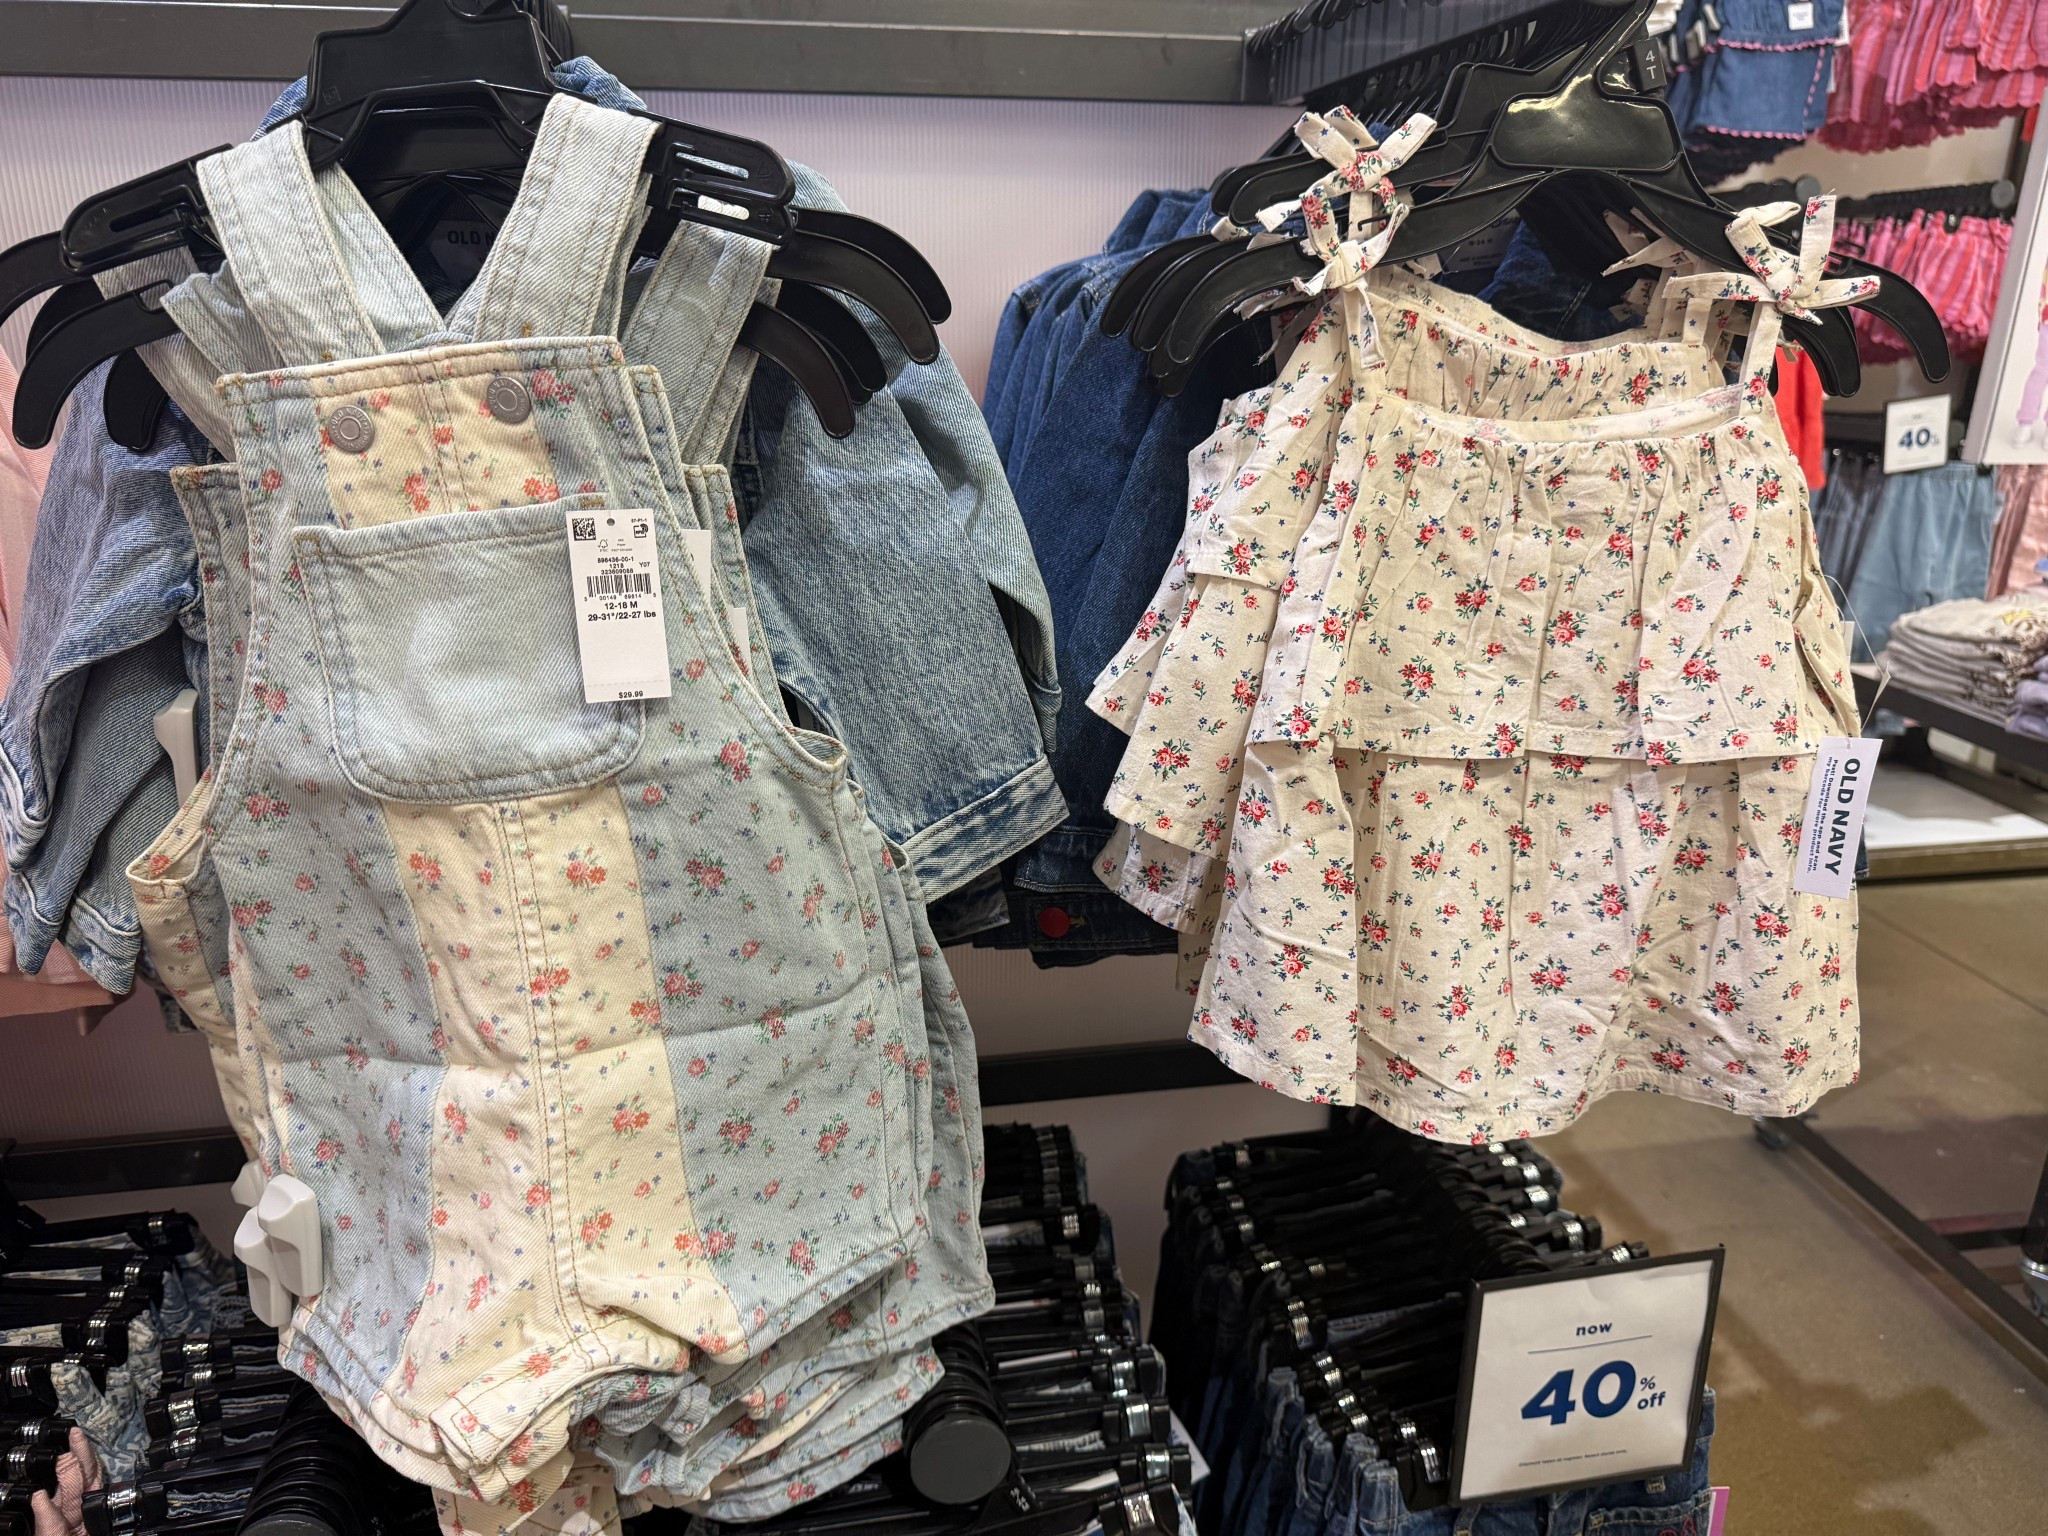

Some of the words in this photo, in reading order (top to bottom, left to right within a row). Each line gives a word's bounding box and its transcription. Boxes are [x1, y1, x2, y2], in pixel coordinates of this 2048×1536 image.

[1646, 50, 1655, 62] 4
[1647, 66, 1656, 79] T
[448, 231, 480, 245] OLD
[1898, 427, 1930, 450] 40
[605, 602, 628, 610] 12-18
[630, 601, 638, 609] M
[619, 691, 643, 699] $29.99
[1826, 757, 1832, 767] my
[1820, 769, 1830, 796] barcode
[1838, 758, 1861, 804] OLD
[1822, 778, 1833, 811] Download
[1825, 810, 1850, 876] NAVY
[1576, 1323, 1613, 1336] now
[1521, 1360, 1636, 1426] 40
[1640, 1376, 1656, 1391] %
[1637, 1392, 1667, 1410] off
